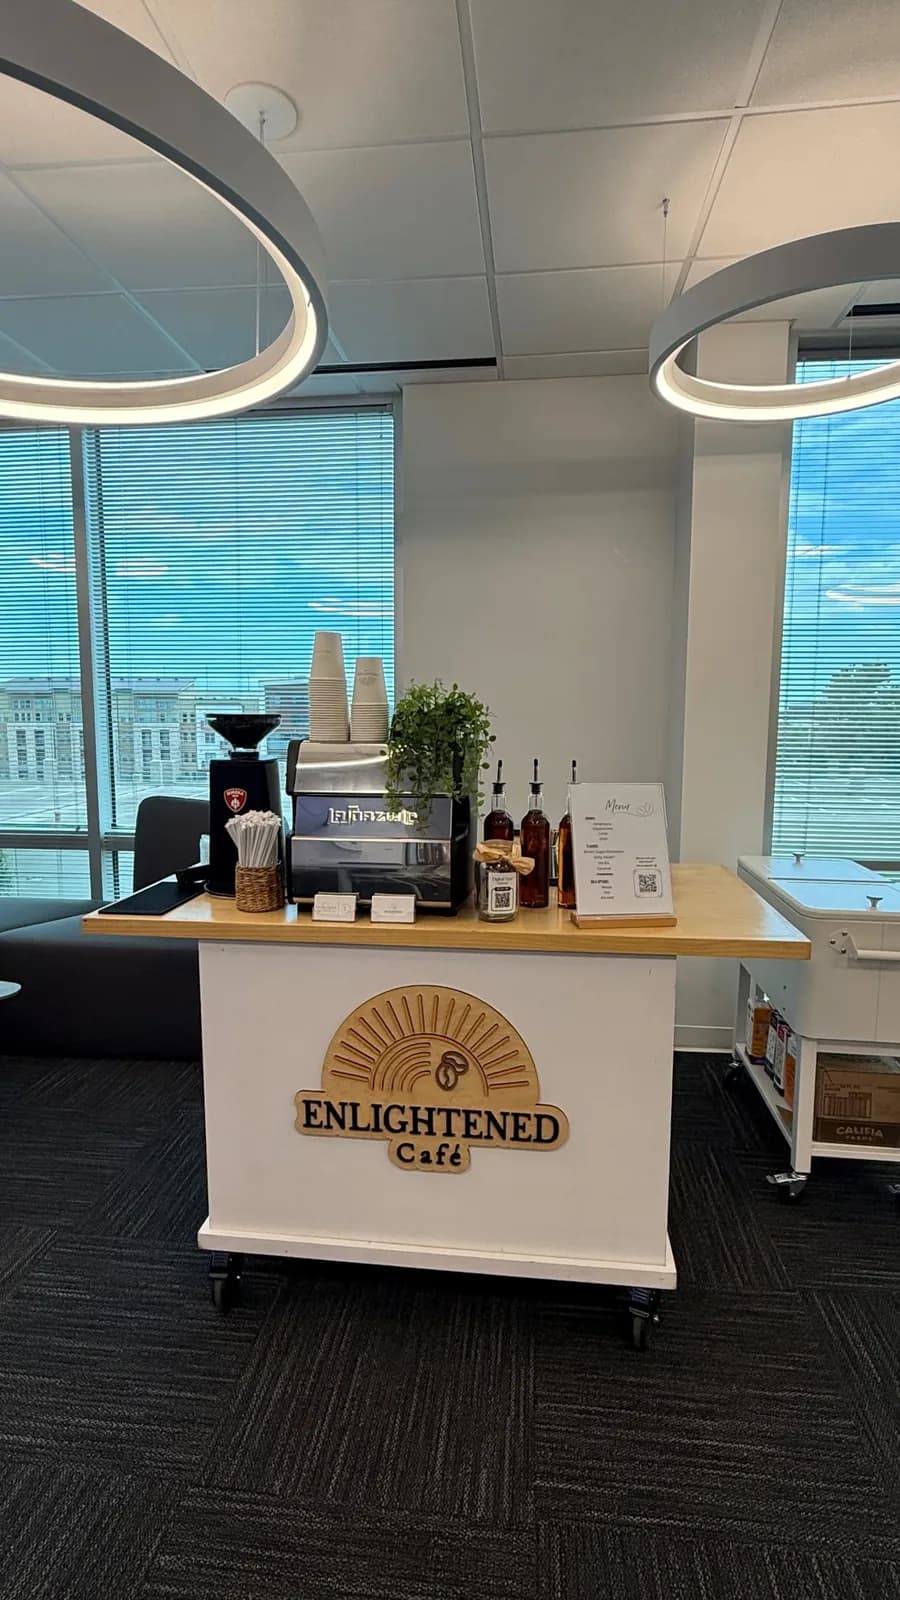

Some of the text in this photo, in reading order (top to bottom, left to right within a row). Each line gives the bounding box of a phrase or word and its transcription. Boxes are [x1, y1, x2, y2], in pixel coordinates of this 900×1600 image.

[605, 799, 630, 813] Menu
[302, 1100, 560, 1144] ENLIGHTENED
[836, 1126, 883, 1137] CALIFIA
[396, 1143, 462, 1166] Café
